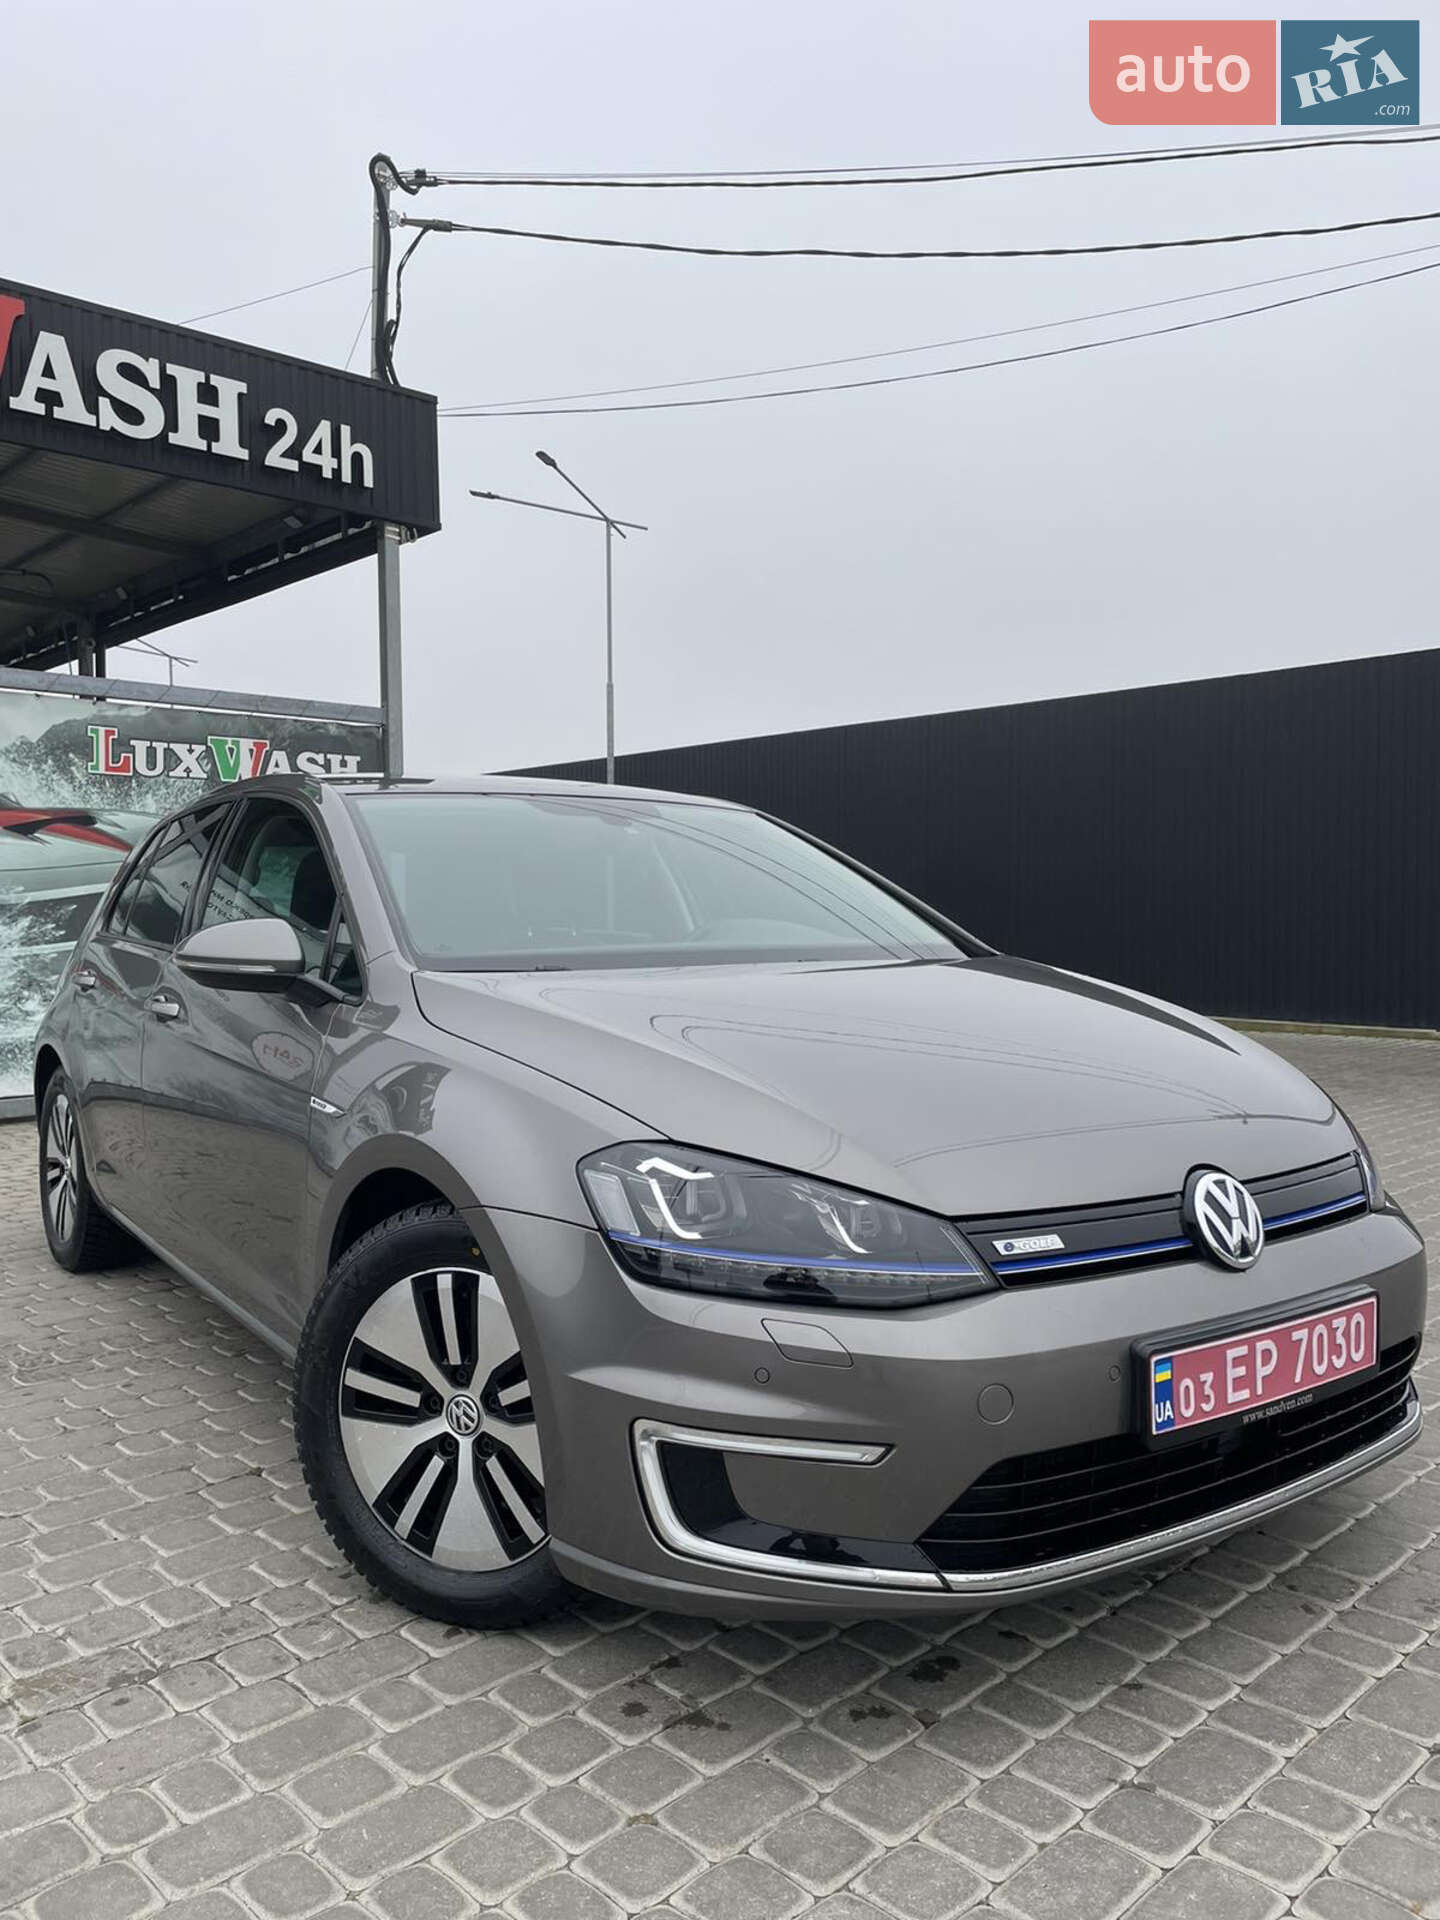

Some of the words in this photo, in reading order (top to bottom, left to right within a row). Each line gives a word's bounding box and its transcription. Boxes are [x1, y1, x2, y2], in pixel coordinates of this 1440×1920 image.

[0, 294, 250, 461] ASH
[263, 407, 374, 489] 24h
[1155, 1401, 1174, 1424] UA
[1179, 1371, 1215, 1419] 03
[1225, 1338, 1279, 1404] EP
[1291, 1312, 1365, 1384] 7030
